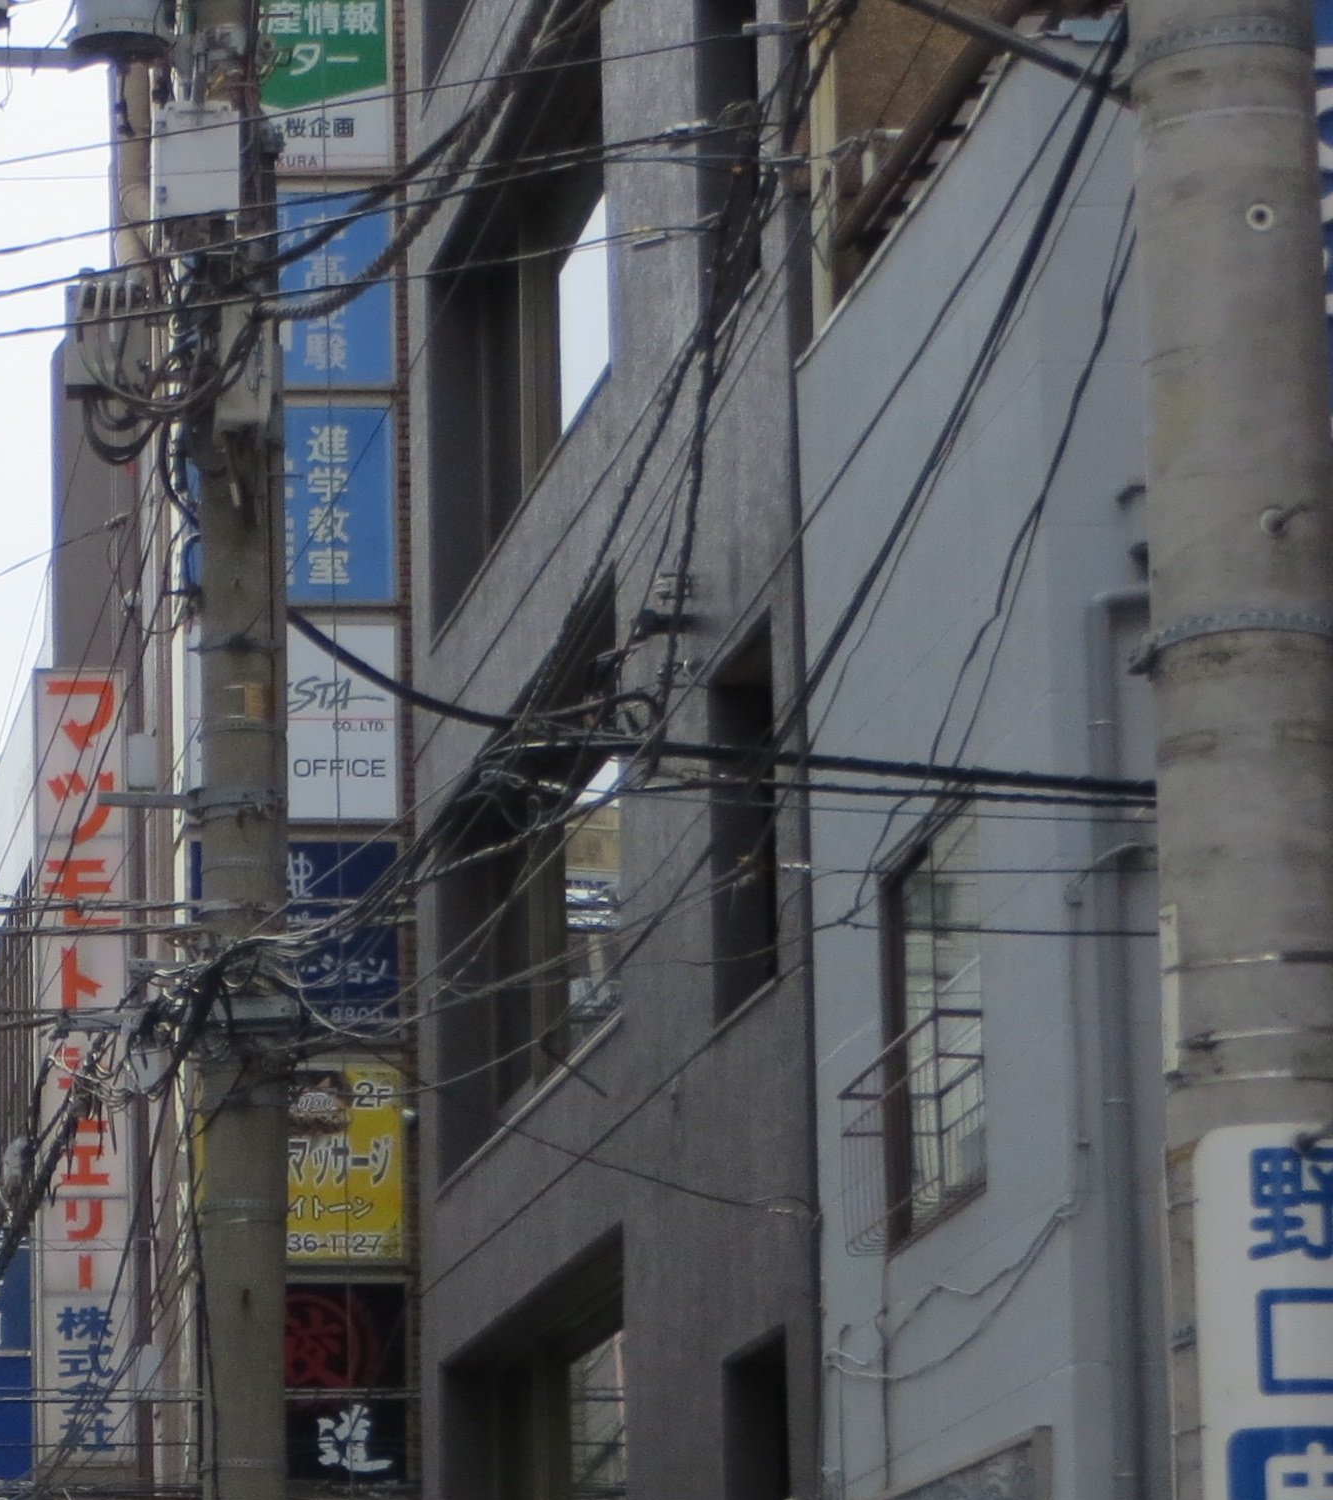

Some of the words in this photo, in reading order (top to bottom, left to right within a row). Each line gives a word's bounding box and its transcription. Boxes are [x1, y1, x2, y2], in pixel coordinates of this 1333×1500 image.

[259, 0, 379, 36] 産情報
[306, 425, 351, 585] 進学教室
[293, 759, 387, 778] OFFICE
[41, 681, 123, 1291] マツモトエリー
[353, 1082, 393, 1109] 2F
[56, 1306, 116, 1454] 株式会社
